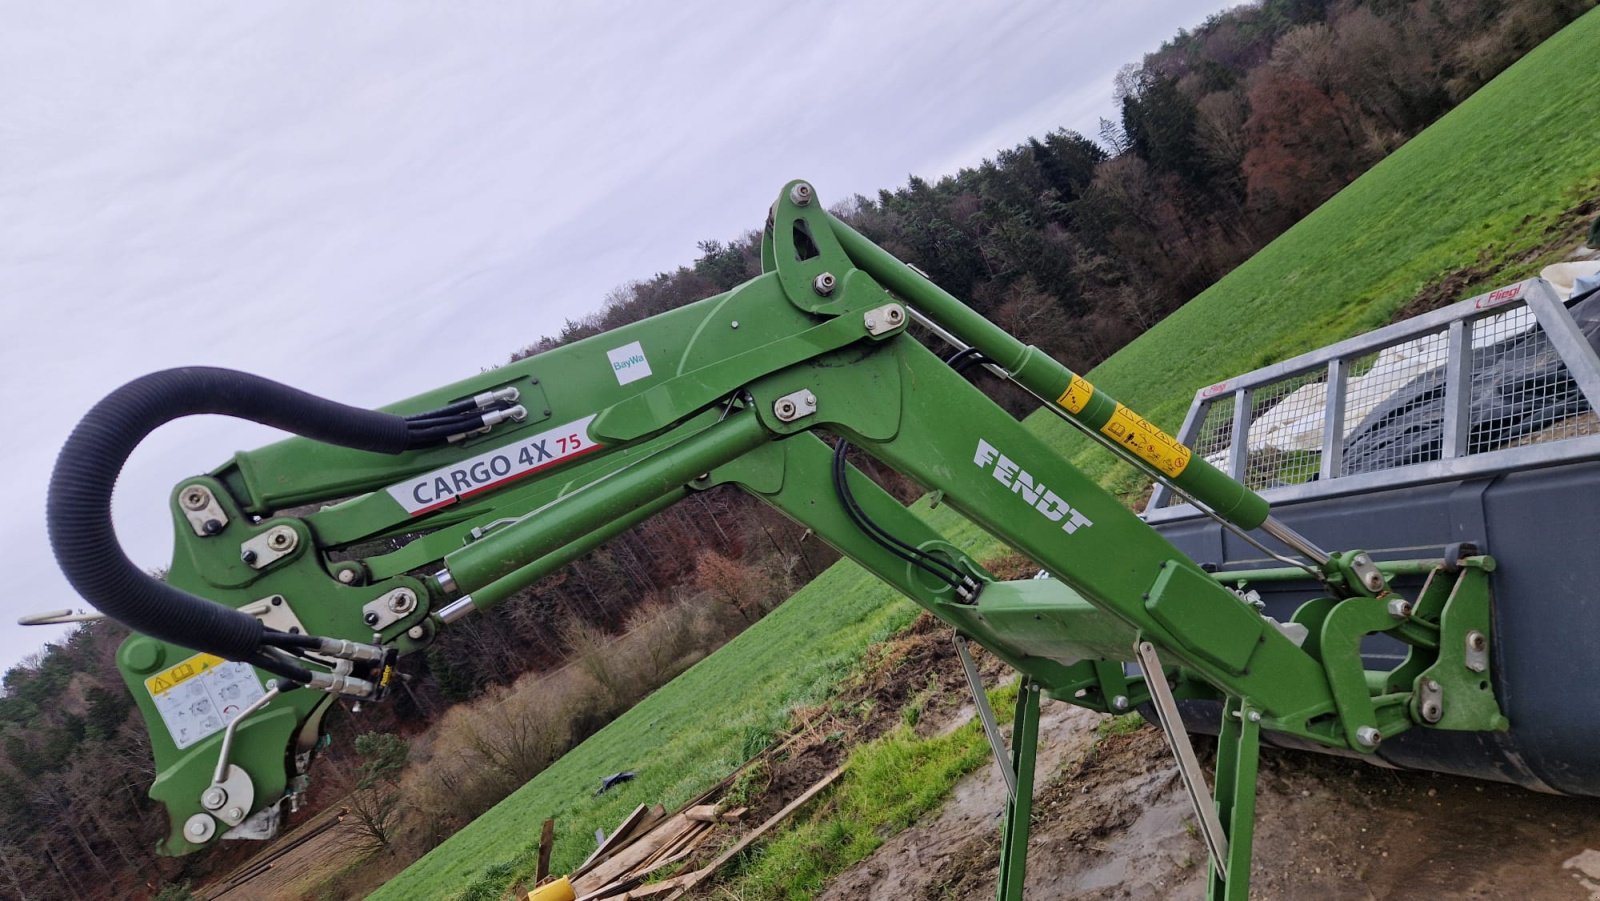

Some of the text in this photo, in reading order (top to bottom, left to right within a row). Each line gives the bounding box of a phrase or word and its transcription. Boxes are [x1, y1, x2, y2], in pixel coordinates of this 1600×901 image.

[613, 353, 645, 371] BayWa
[412, 433, 582, 504] CARGO 4X 75
[973, 438, 1093, 535] FENDT
